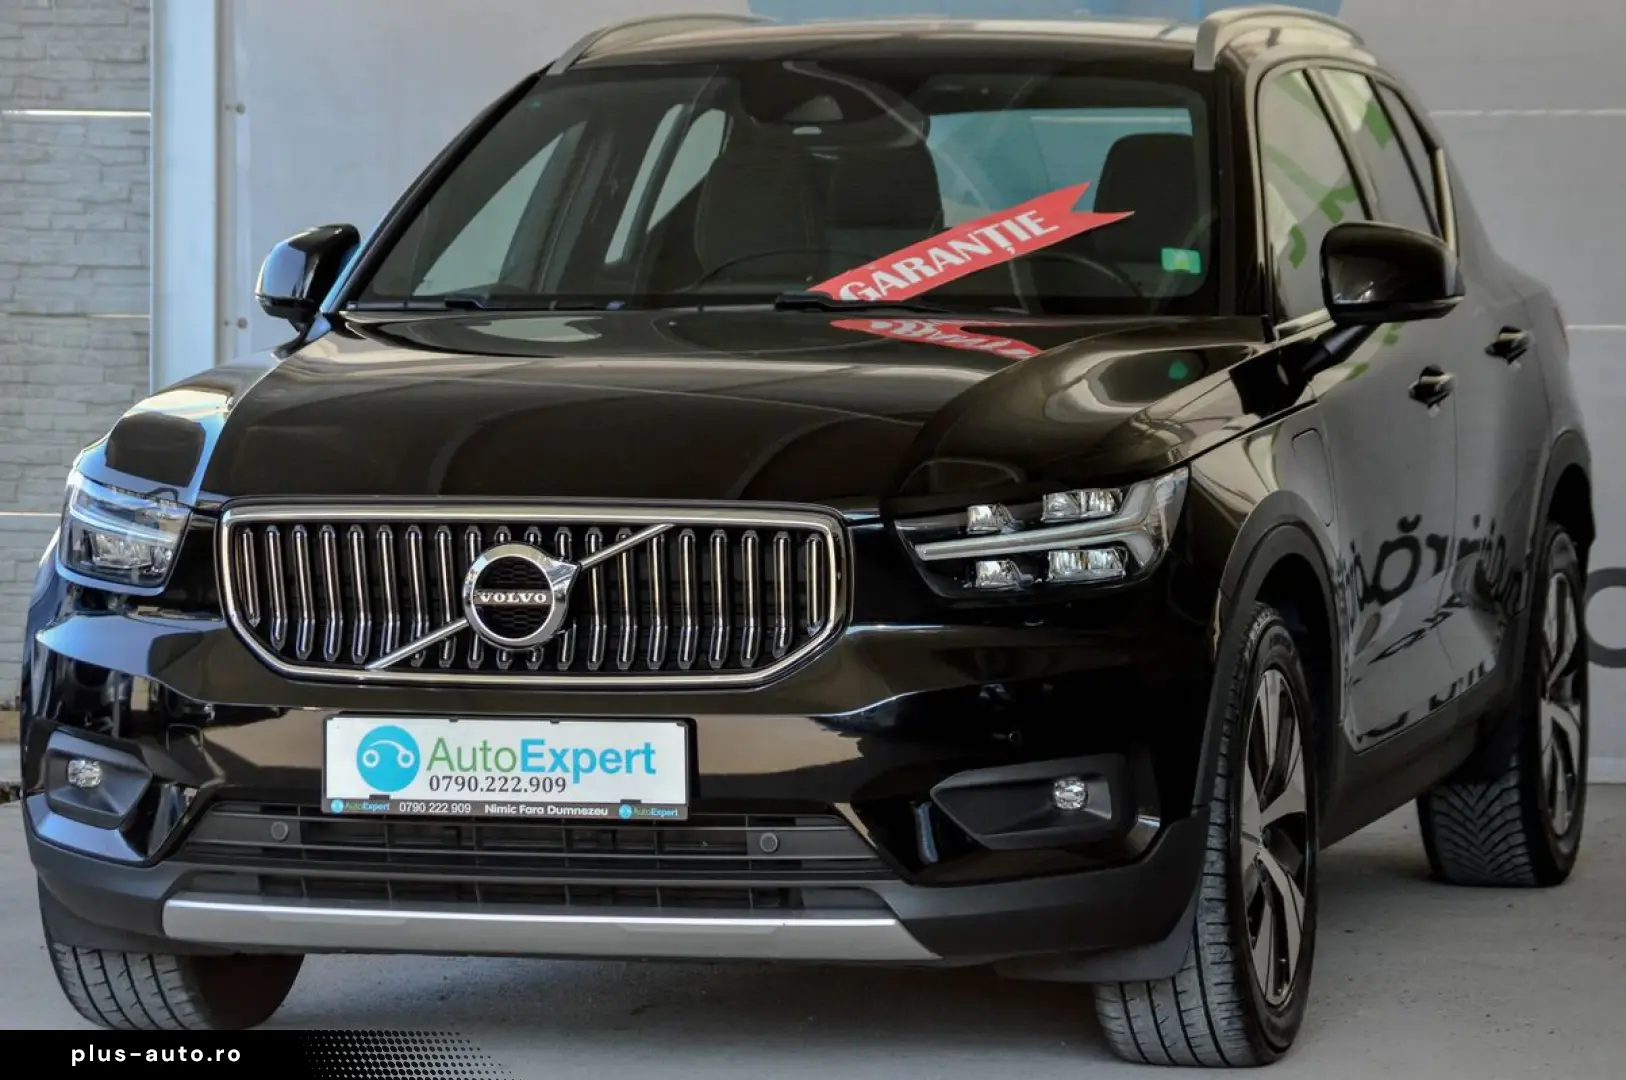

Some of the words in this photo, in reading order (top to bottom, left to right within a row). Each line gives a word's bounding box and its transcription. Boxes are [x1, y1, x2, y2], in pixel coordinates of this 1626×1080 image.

[839, 209, 1060, 302] GARANȚIE
[479, 592, 547, 603] VOLVO
[426, 737, 657, 785] AutoExpert
[429, 775, 567, 793] 0790.222.909
[399, 802, 426, 813] 0790
[429, 802, 449, 813] 222
[451, 803, 472, 814] 909
[484, 804, 517, 815] Nimic
[519, 804, 545, 815] Fara
[547, 805, 609, 816] Dumnezeu
